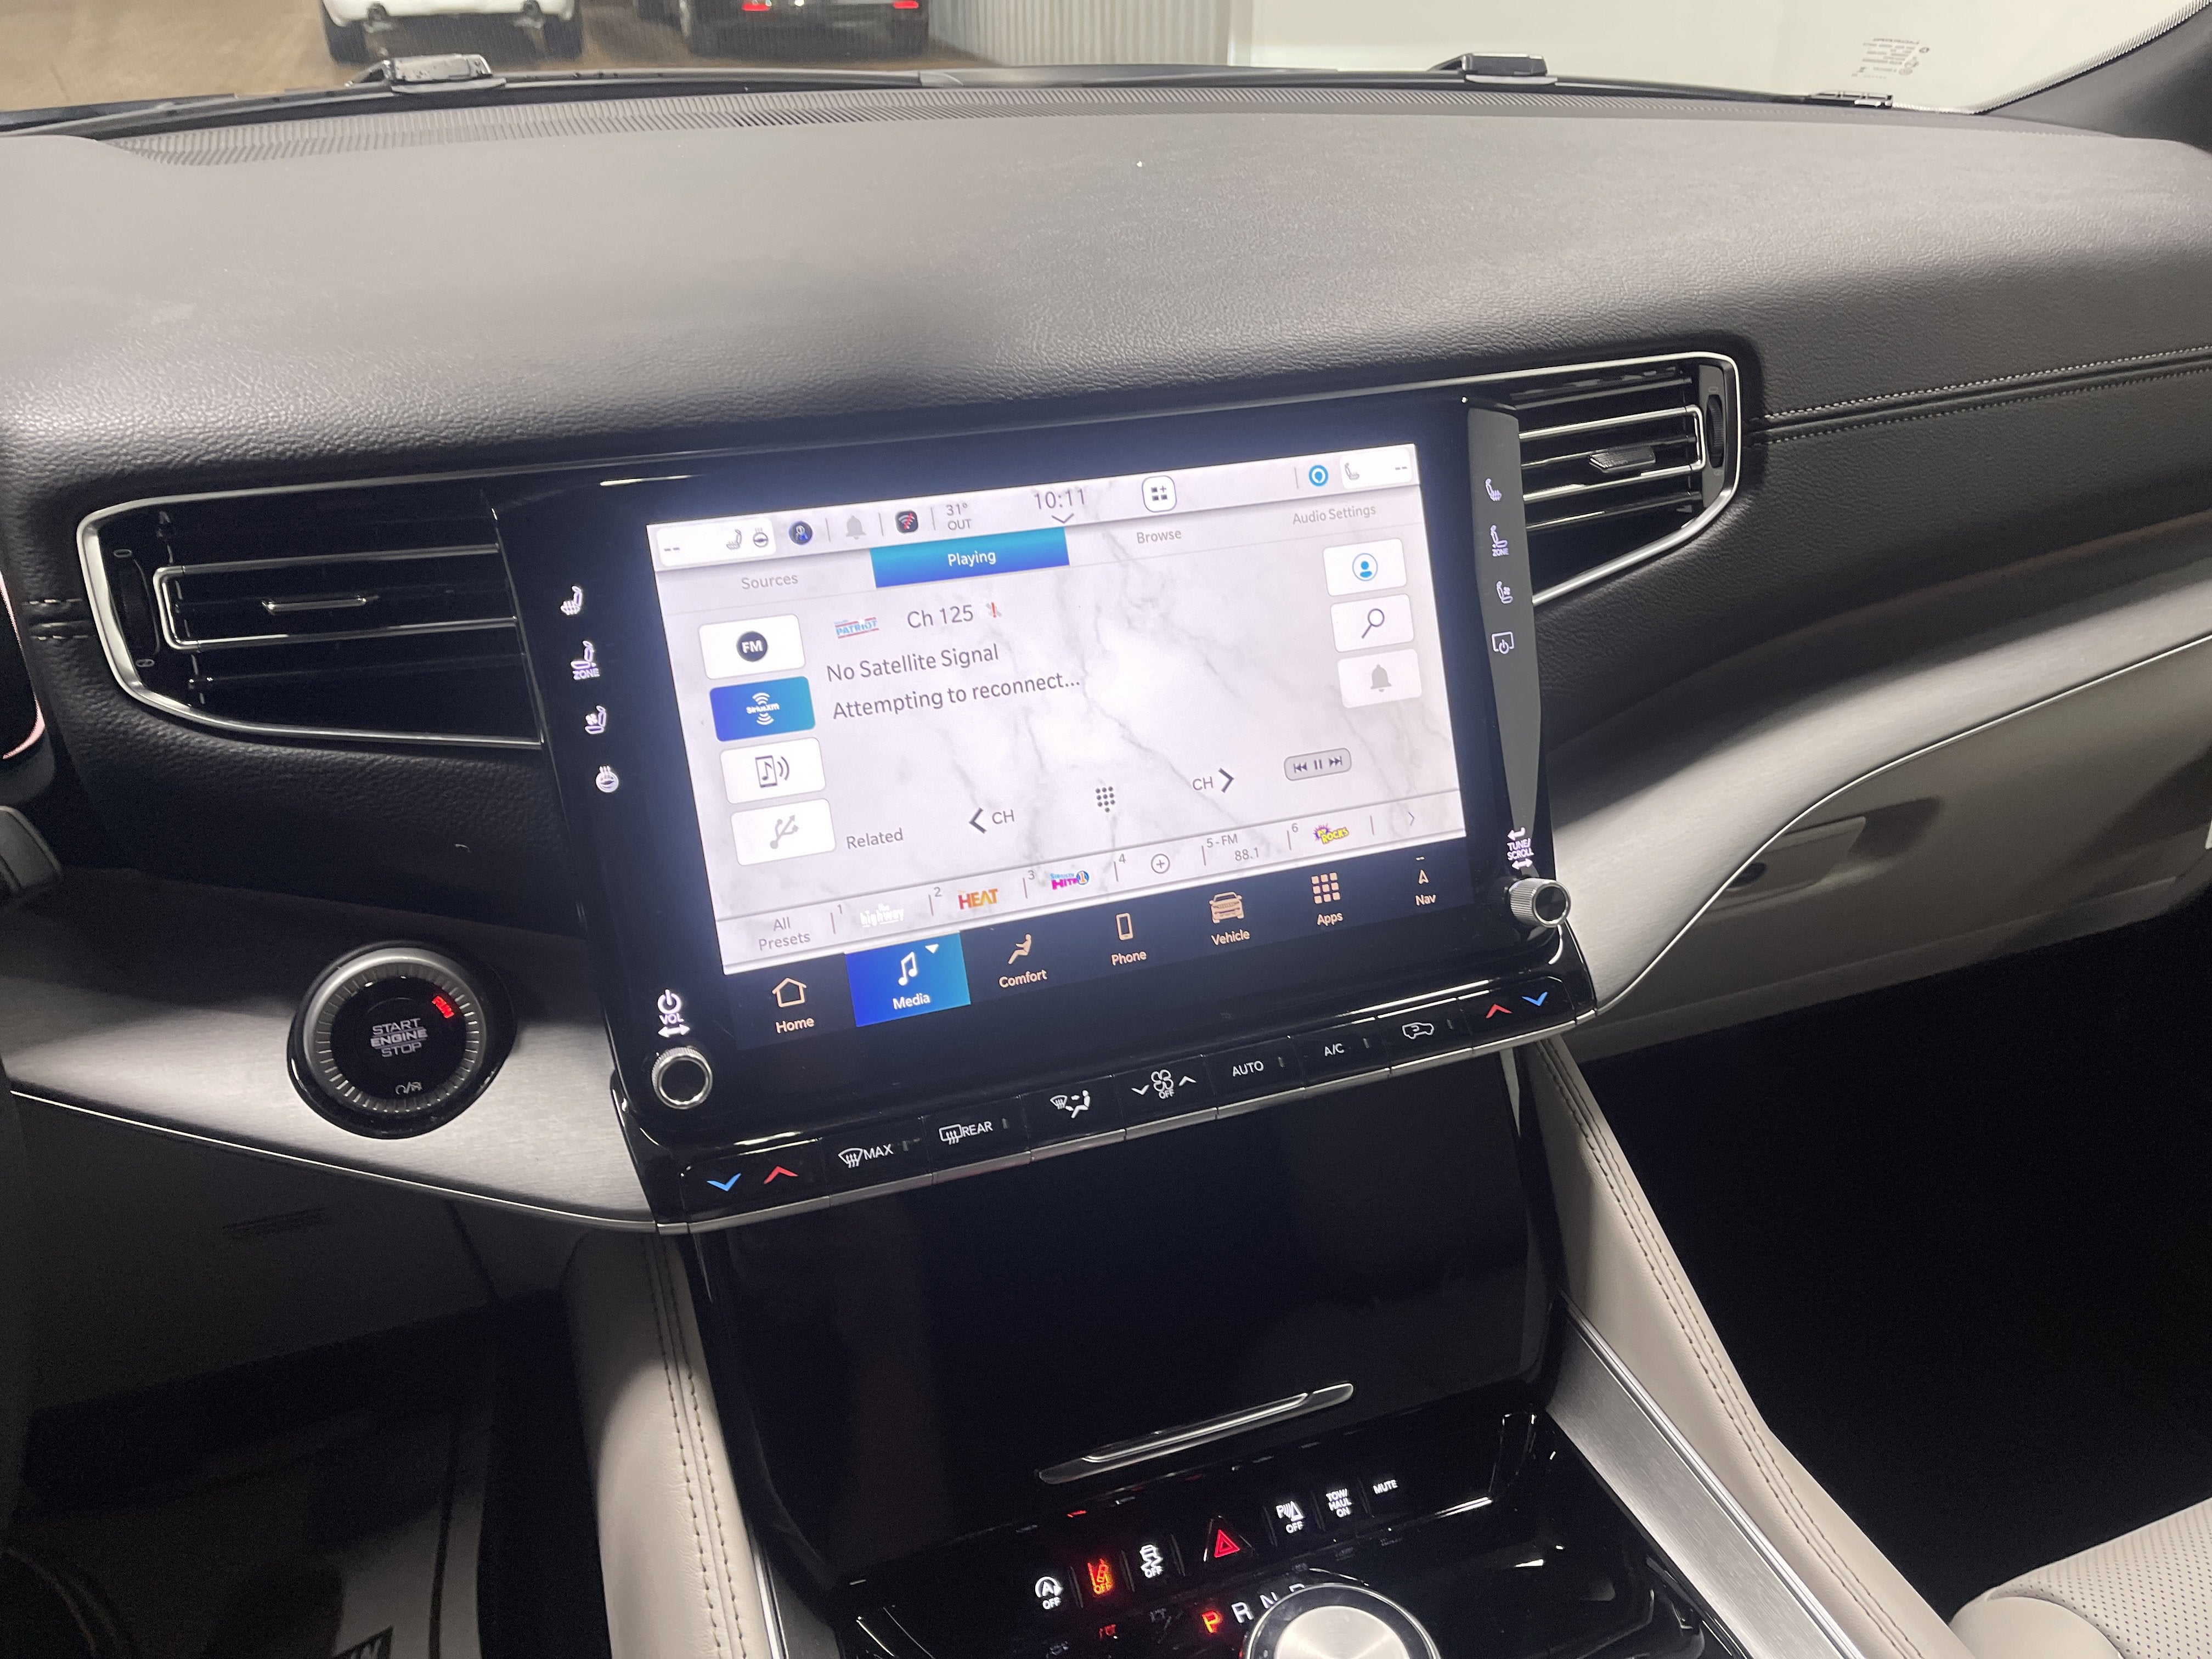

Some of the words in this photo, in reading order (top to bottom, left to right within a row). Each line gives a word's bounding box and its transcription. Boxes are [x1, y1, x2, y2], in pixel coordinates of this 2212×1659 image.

[1034, 488, 1085, 510] 10:11
[946, 502, 968, 516] 31°
[1292, 510, 1327, 526] Audio
[1328, 504, 1376, 522] Settings
[947, 519, 971, 531] OUT
[1136, 528, 1182, 545] Browse
[947, 550, 996, 567] Playing
[1492, 548, 1509, 557] ZONE
[741, 572, 798, 590] Sources
[907, 610, 934, 629] Ch
[939, 604, 974, 624] 125
[741, 639, 764, 654] FM
[827, 664, 855, 682] No
[859, 653, 936, 678] Satellite
[940, 643, 998, 668] Signal
[572, 667, 600, 680] ZONE
[833, 691, 944, 720] Attempting
[946, 687, 967, 703] to
[972, 672, 1081, 700] reconnect...
[1192, 776, 1214, 791] CH
[992, 809, 1015, 825] CH
[1291, 822, 1299, 833] 6
[846, 827, 904, 850] Related
[1118, 854, 1126, 864] 4
[1234, 847, 1260, 861] 88.1
[1507, 848, 1534, 861] SCROLL
[1028, 870, 1036, 881] 3
[933, 886, 943, 898] 2
[957, 888, 998, 910] HEAT
[1415, 892, 1436, 906] Nav
[837, 904, 843, 915] 1
[773, 916, 791, 932] All
[1317, 911, 1344, 927] Apps
[758, 932, 811, 951] Presets
[1211, 928, 1251, 946] Vehicle
[1110, 949, 1147, 966] Phone
[998, 969, 1048, 989] Comfort
[893, 994, 931, 1011] Media
[373, 1018, 421, 1036] START
[659, 1013, 685, 1025] VOL
[775, 1015, 815, 1034] Home
[370, 1029, 428, 1048] ENGINE
[381, 1042, 422, 1058] STOP
[1324, 1043, 1345, 1057] A/C
[1232, 1060, 1265, 1077] AUTO
[1158, 1088, 1175, 1099] OFF
[961, 1120, 994, 1138] REAR
[864, 1143, 894, 1161] MAX
[1373, 1479, 1398, 1494] MUTE
[1325, 1488, 1349, 1502] TOW/
[1328, 1497, 1352, 1511] HAUL
[1335, 1506, 1351, 1518] ON
[1285, 1520, 1304, 1534] OFF
[1144, 1565, 1163, 1579] OFF
[1093, 1582, 1113, 1595] OFF
[1042, 1596, 1062, 1610] OFF
[1201, 1610, 1220, 1633] P
[1231, 1601, 1254, 1624] R
